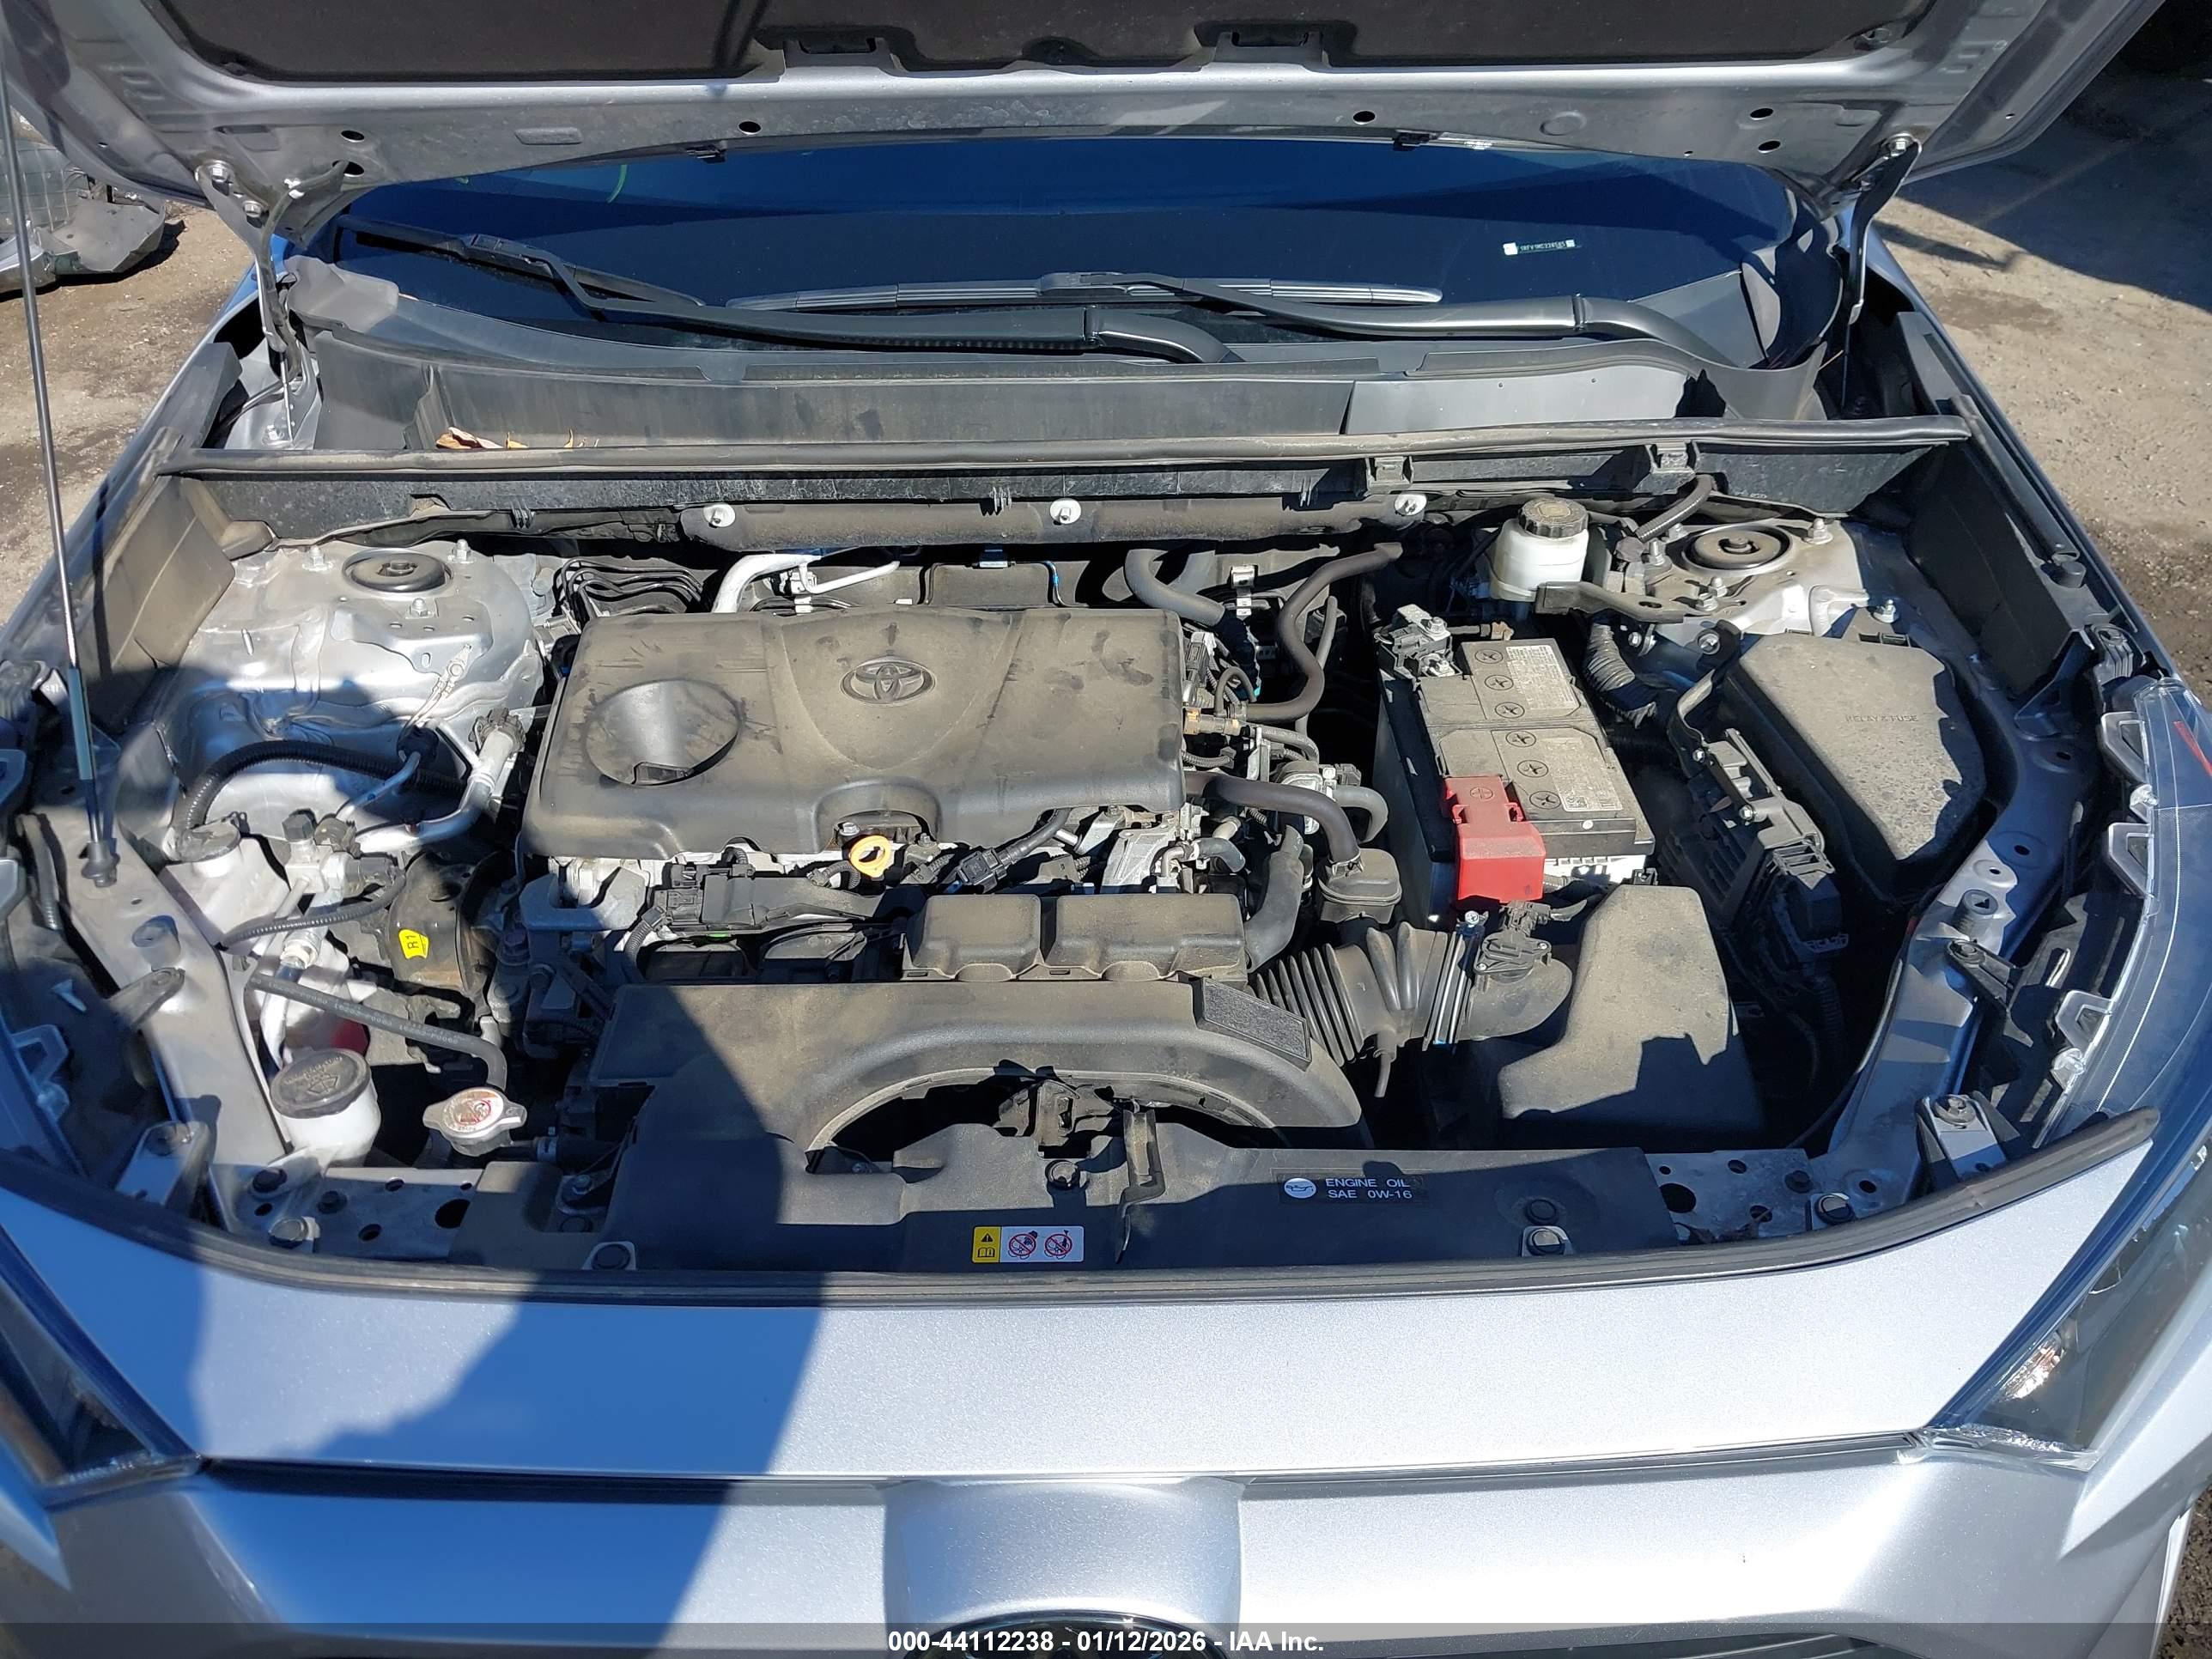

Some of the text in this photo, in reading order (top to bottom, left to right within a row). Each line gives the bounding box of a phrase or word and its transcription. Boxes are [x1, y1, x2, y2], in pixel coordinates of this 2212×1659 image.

[405, 936, 420, 950] R1
[1325, 1178, 1410, 1188] ENGINE OIL
[1328, 1189, 1413, 1199] SAE 0W-16
